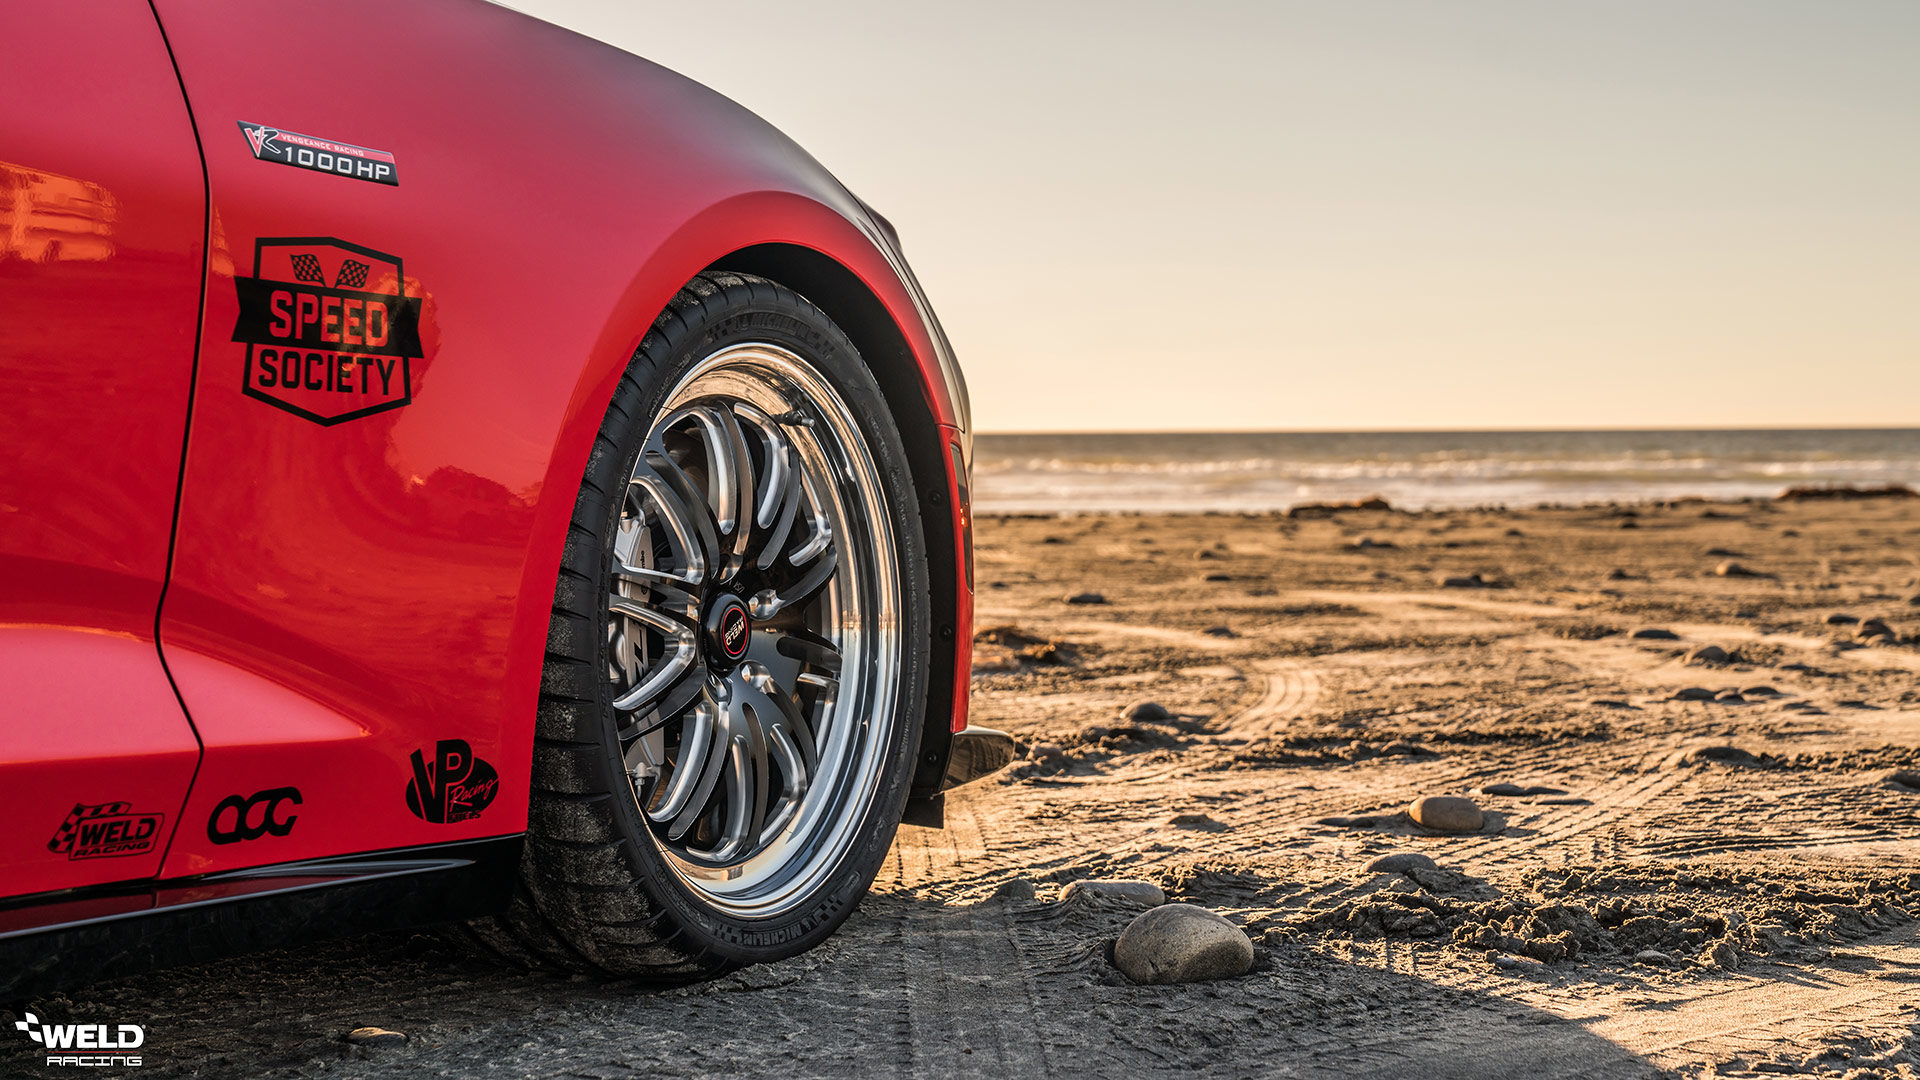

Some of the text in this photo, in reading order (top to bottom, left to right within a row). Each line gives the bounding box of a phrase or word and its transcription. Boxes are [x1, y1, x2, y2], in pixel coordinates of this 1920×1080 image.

[281, 133, 364, 157] VENGEANCE RACING
[285, 147, 390, 180] 1000HP
[269, 289, 388, 347] SPEED
[258, 348, 396, 395] SOCIETY
[410, 739, 473, 824] VP
[449, 779, 499, 813] Racing
[80, 817, 156, 847] WELD
[73, 841, 151, 858] RACING
[741, 923, 803, 946] MICHELIN
